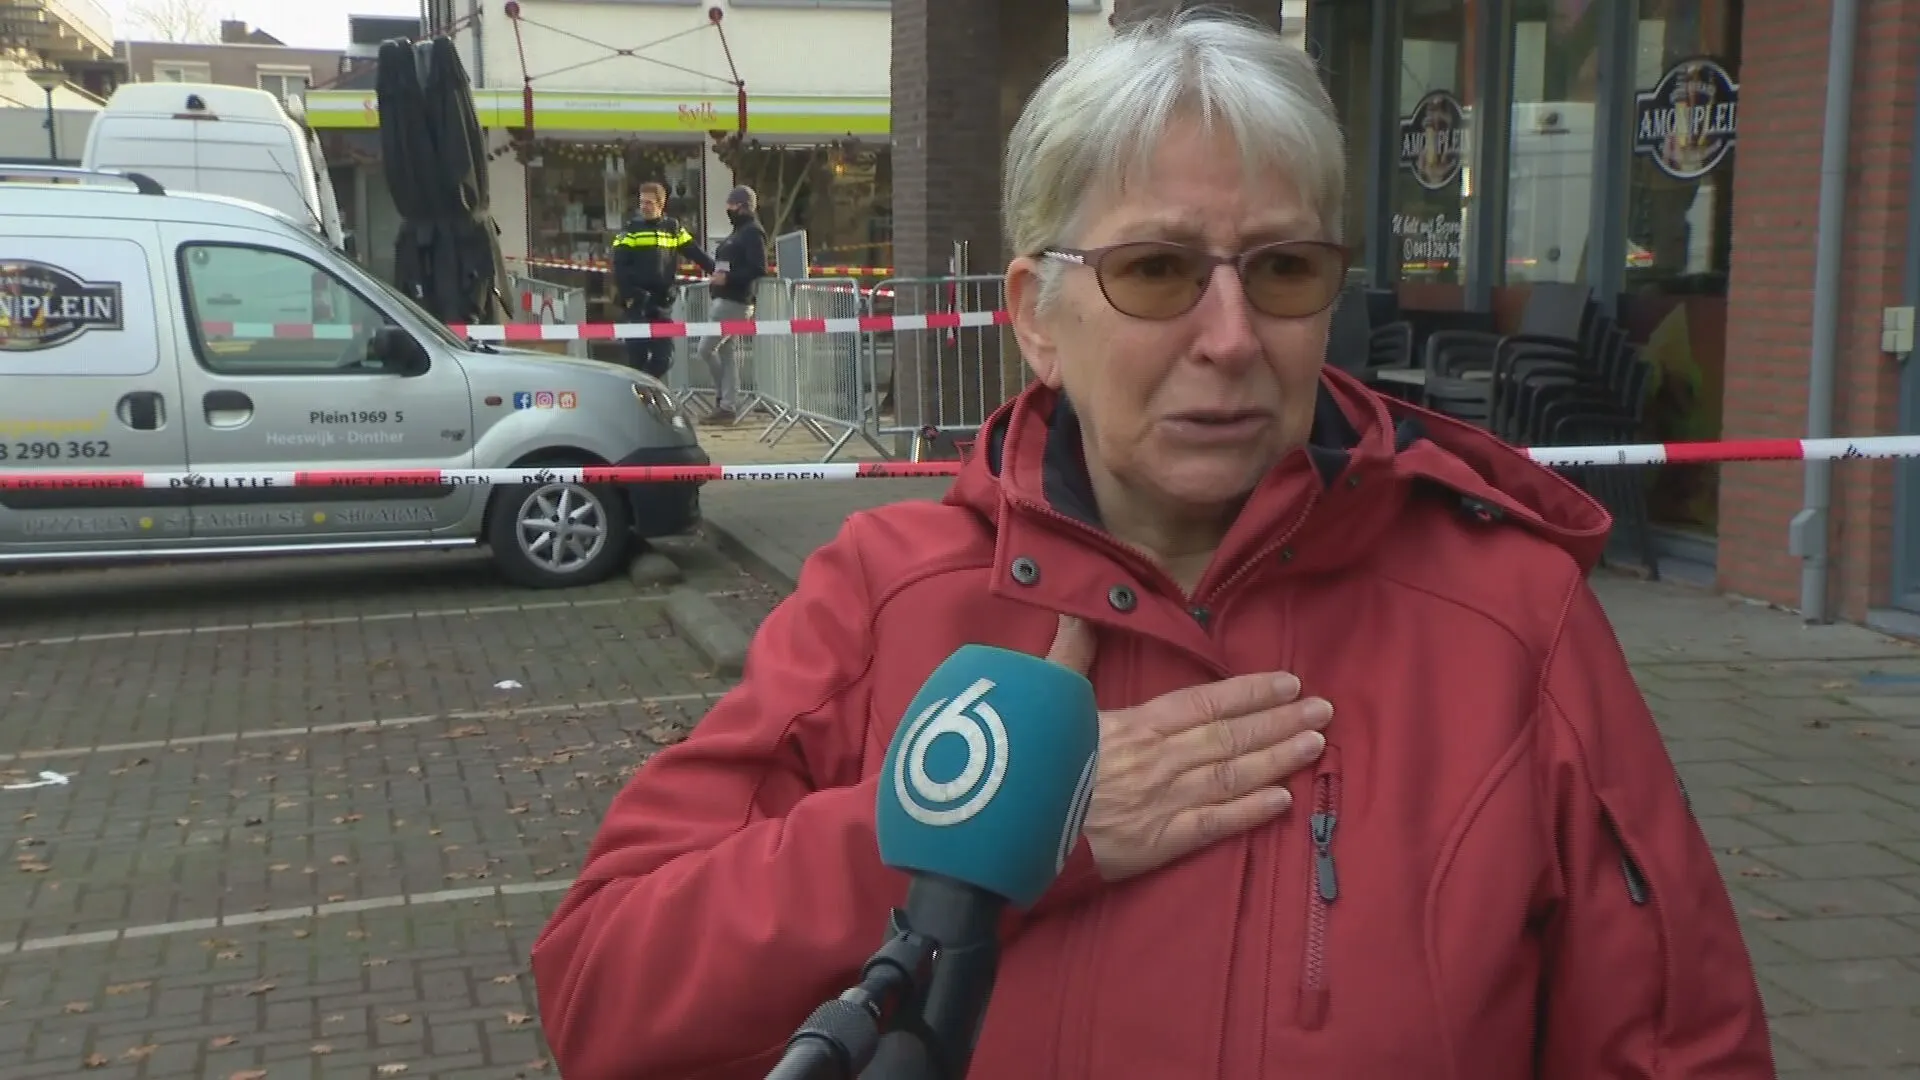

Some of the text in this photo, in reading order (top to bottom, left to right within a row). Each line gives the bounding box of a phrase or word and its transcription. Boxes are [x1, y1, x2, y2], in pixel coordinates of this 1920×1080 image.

[1694, 102, 1737, 134] PLEI
[395, 411, 404, 423] 5
[266, 431, 336, 447] Heeswijk
[348, 430, 405, 444] Dinther
[16, 442, 60, 459] 290
[67, 441, 111, 458] 362
[895, 678, 1008, 826] 6
